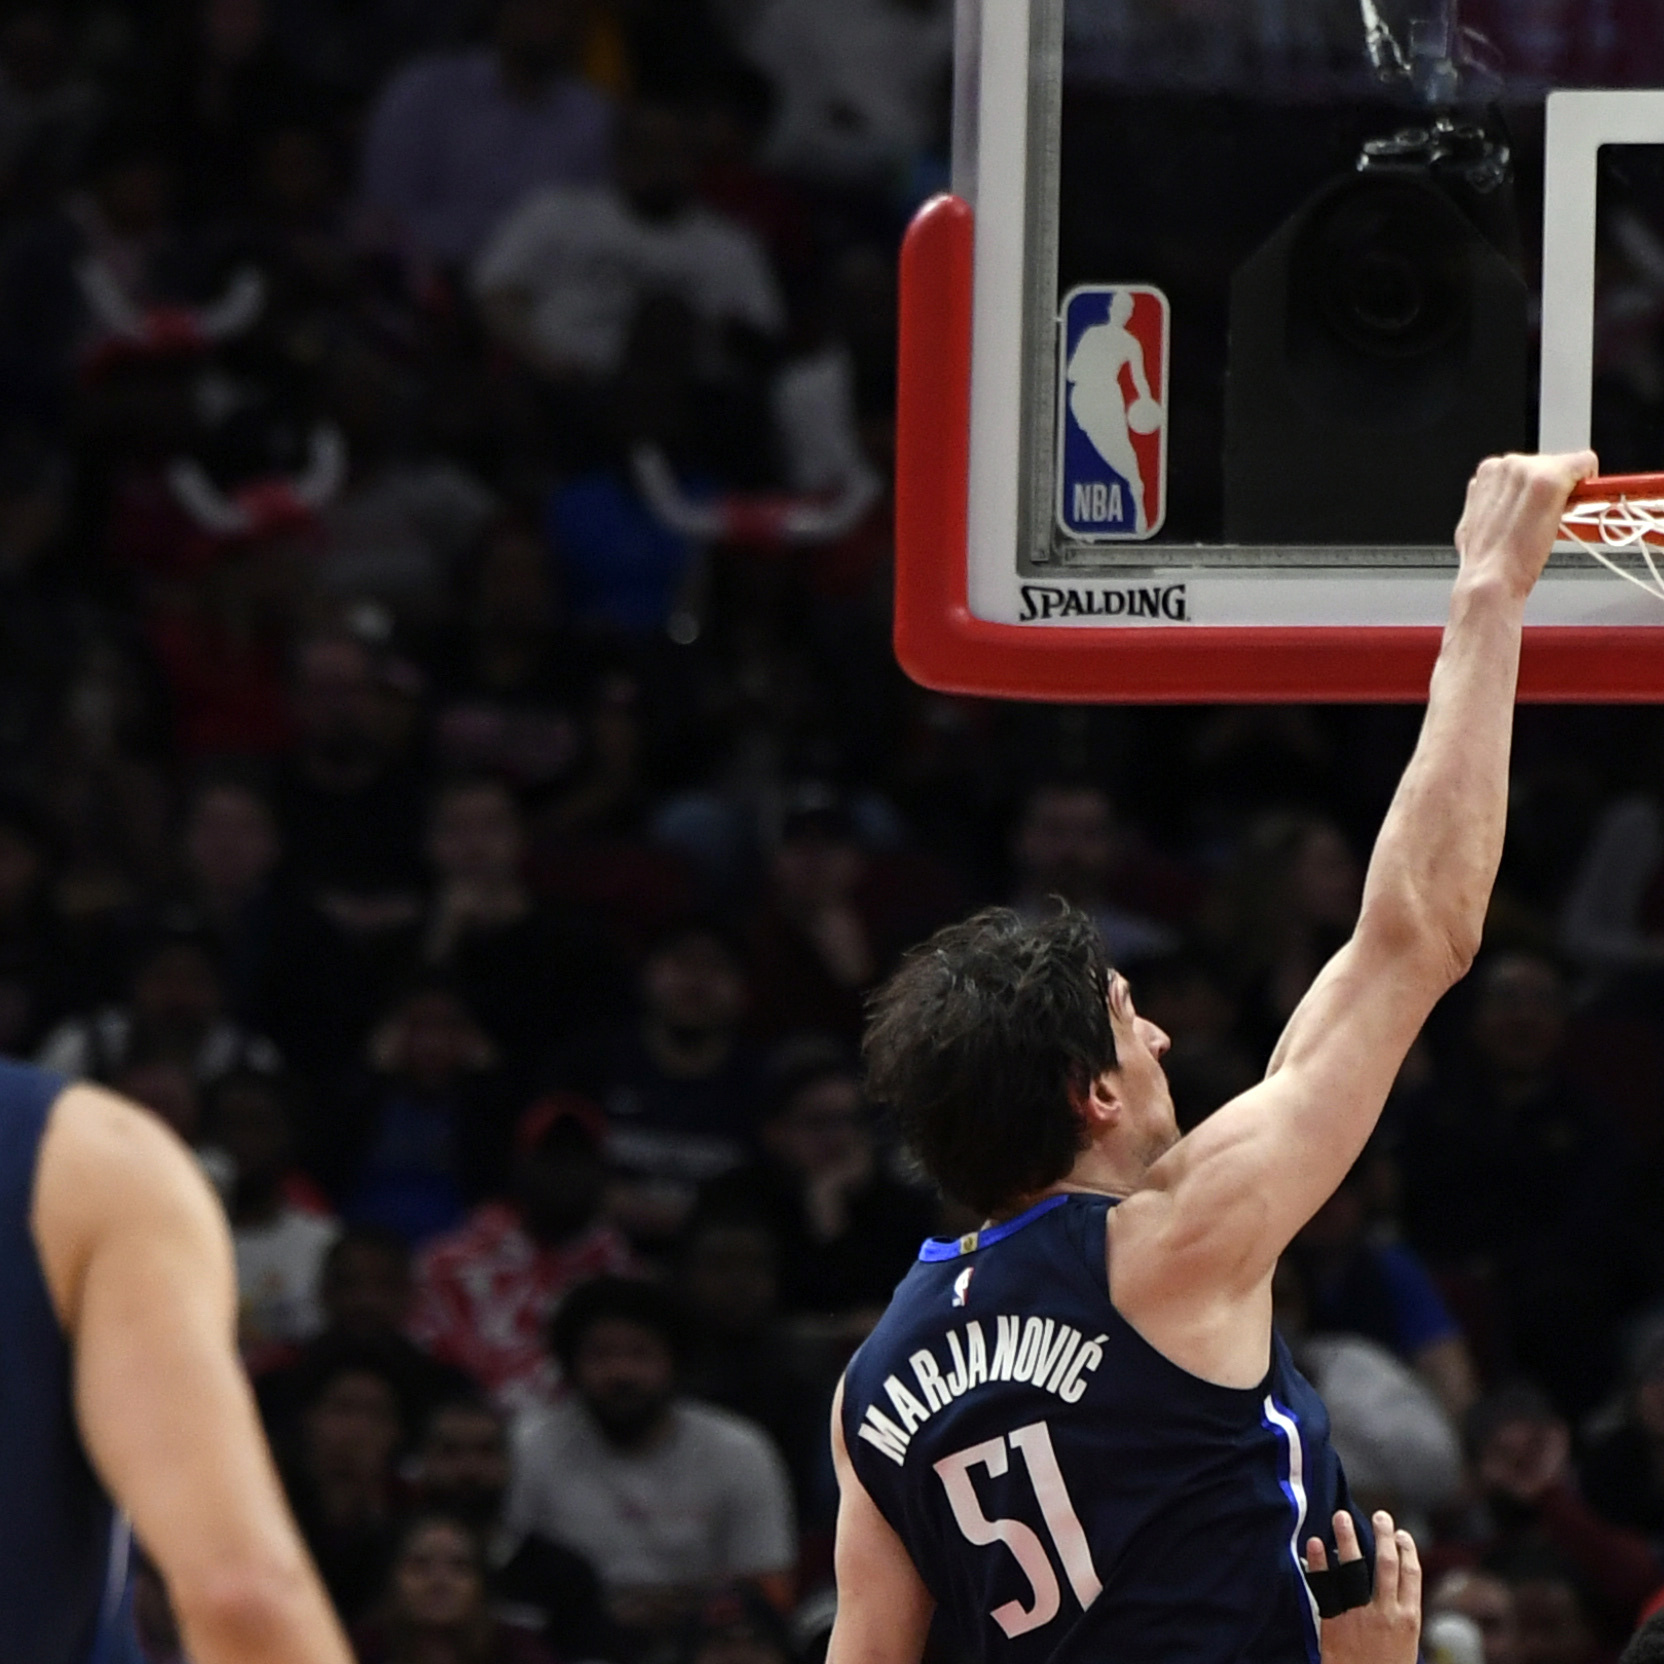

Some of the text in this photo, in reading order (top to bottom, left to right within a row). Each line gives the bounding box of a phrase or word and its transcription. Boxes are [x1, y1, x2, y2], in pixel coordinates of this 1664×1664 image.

[1073, 483, 1124, 523] NBA
[1019, 583, 1186, 622] SPALDING
[857, 1314, 1111, 1467] MARJANOVIĆ
[932, 1420, 1104, 1640] 51
